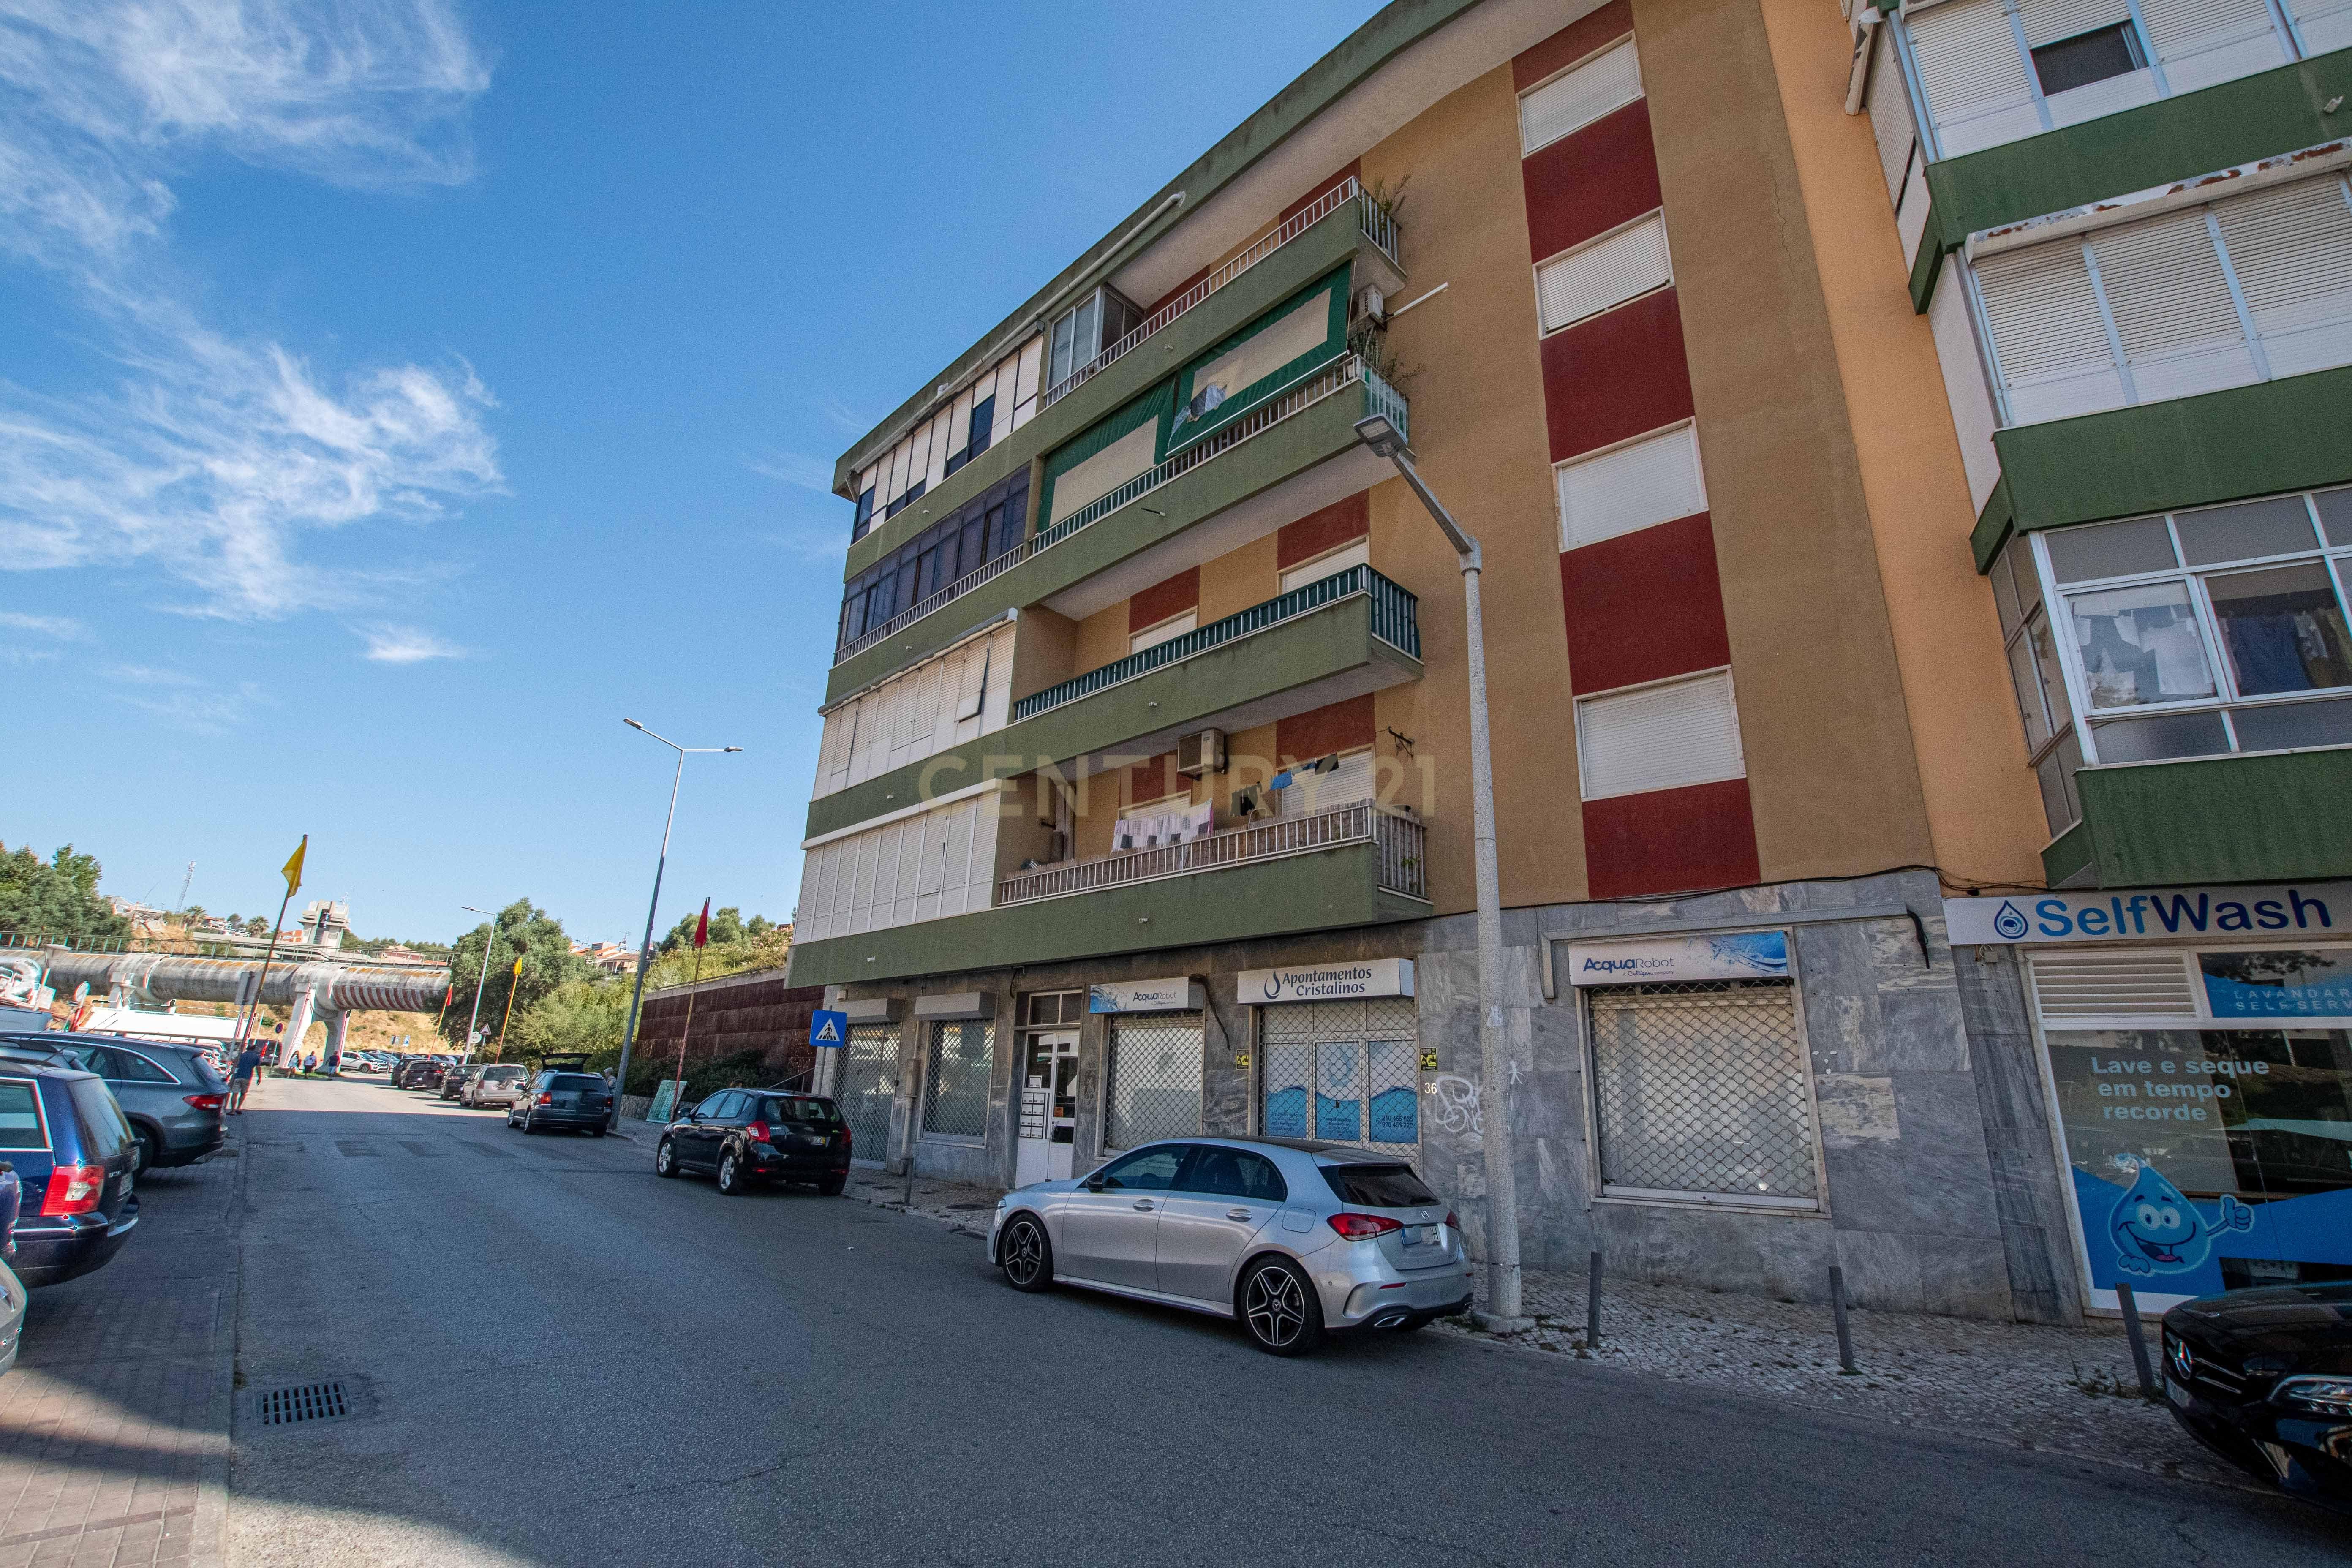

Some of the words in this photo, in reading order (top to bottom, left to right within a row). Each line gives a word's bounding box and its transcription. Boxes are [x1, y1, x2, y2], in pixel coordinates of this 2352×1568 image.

[2035, 889, 2332, 937] SelfWash
[1583, 957, 1674, 974] AcquaRobot
[1282, 967, 1372, 988] Apontamentos
[1133, 992, 1176, 1003] AcquaRobot
[1296, 981, 1365, 996] Cristalinos
[2091, 1056, 2153, 1074] Lave
[2160, 1060, 2176, 1074] e
[2184, 1060, 2271, 1079] seque
[1424, 1082, 1437, 1094] 36
[2097, 1083, 2137, 1097] em
[2144, 1081, 2232, 1102] tempo
[2103, 1103, 2209, 1121] recorde
